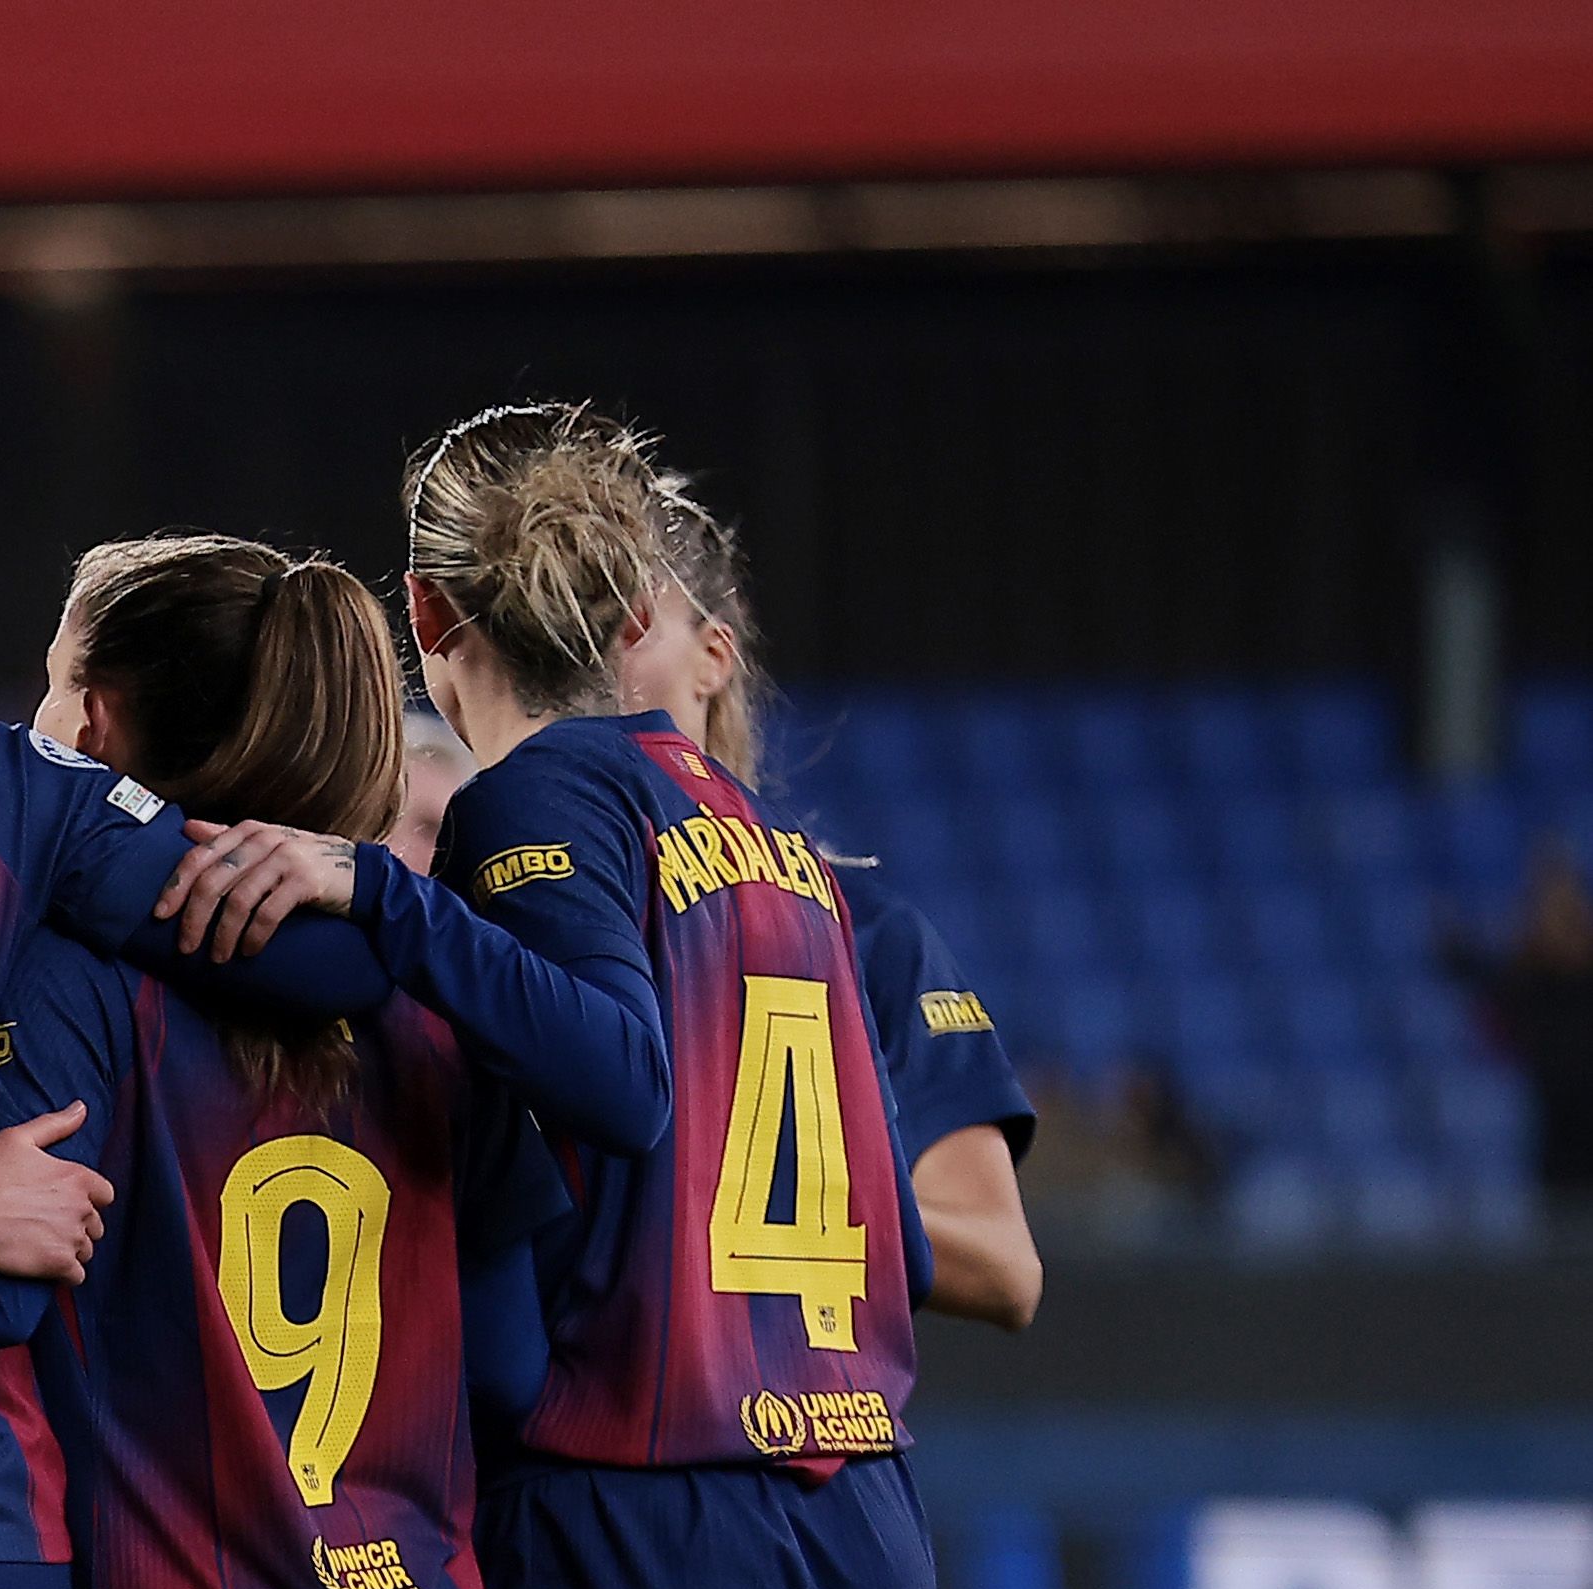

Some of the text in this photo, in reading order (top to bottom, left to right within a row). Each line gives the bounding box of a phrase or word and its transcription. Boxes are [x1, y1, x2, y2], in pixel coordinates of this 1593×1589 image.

[481, 850, 571, 892] IMBO
[657, 802, 840, 924] MARÍALEÓ
[710, 975, 868, 1352] 4
[218, 1135, 391, 1507] 9
[799, 1391, 889, 1418] UNHCR
[813, 1417, 894, 1442] ACNUR
